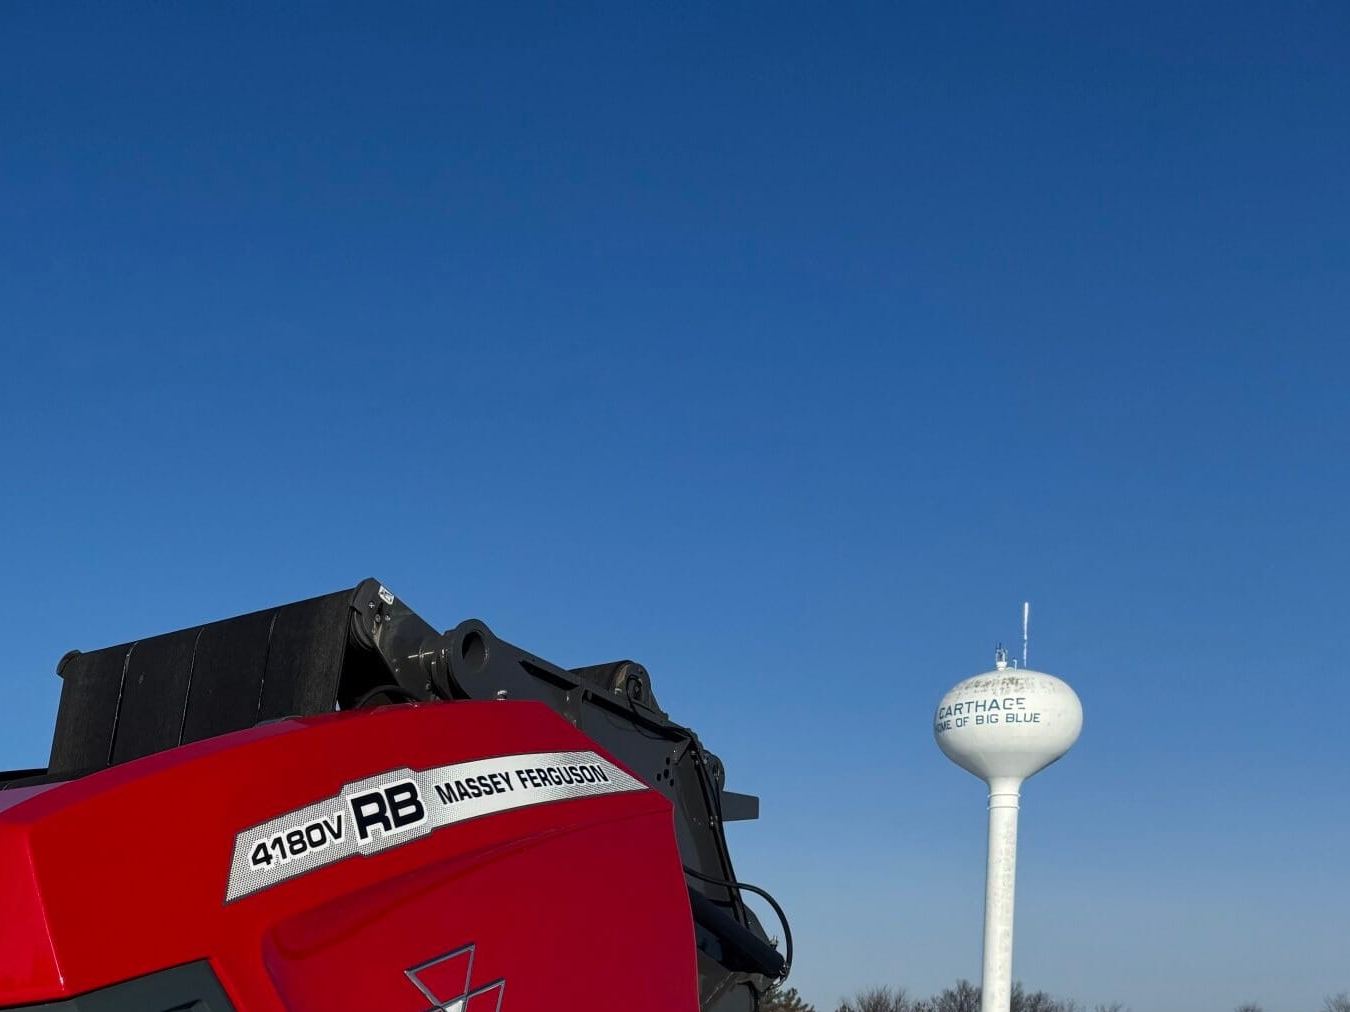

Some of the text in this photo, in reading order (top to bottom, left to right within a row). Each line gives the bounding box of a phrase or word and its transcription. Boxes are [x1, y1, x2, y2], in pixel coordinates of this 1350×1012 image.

[938, 697, 1026, 720] CARTHAGE
[935, 712, 1041, 734] OME OF BIG BLUE
[251, 764, 610, 866] 4180V RB MASSEY FERGUSON
